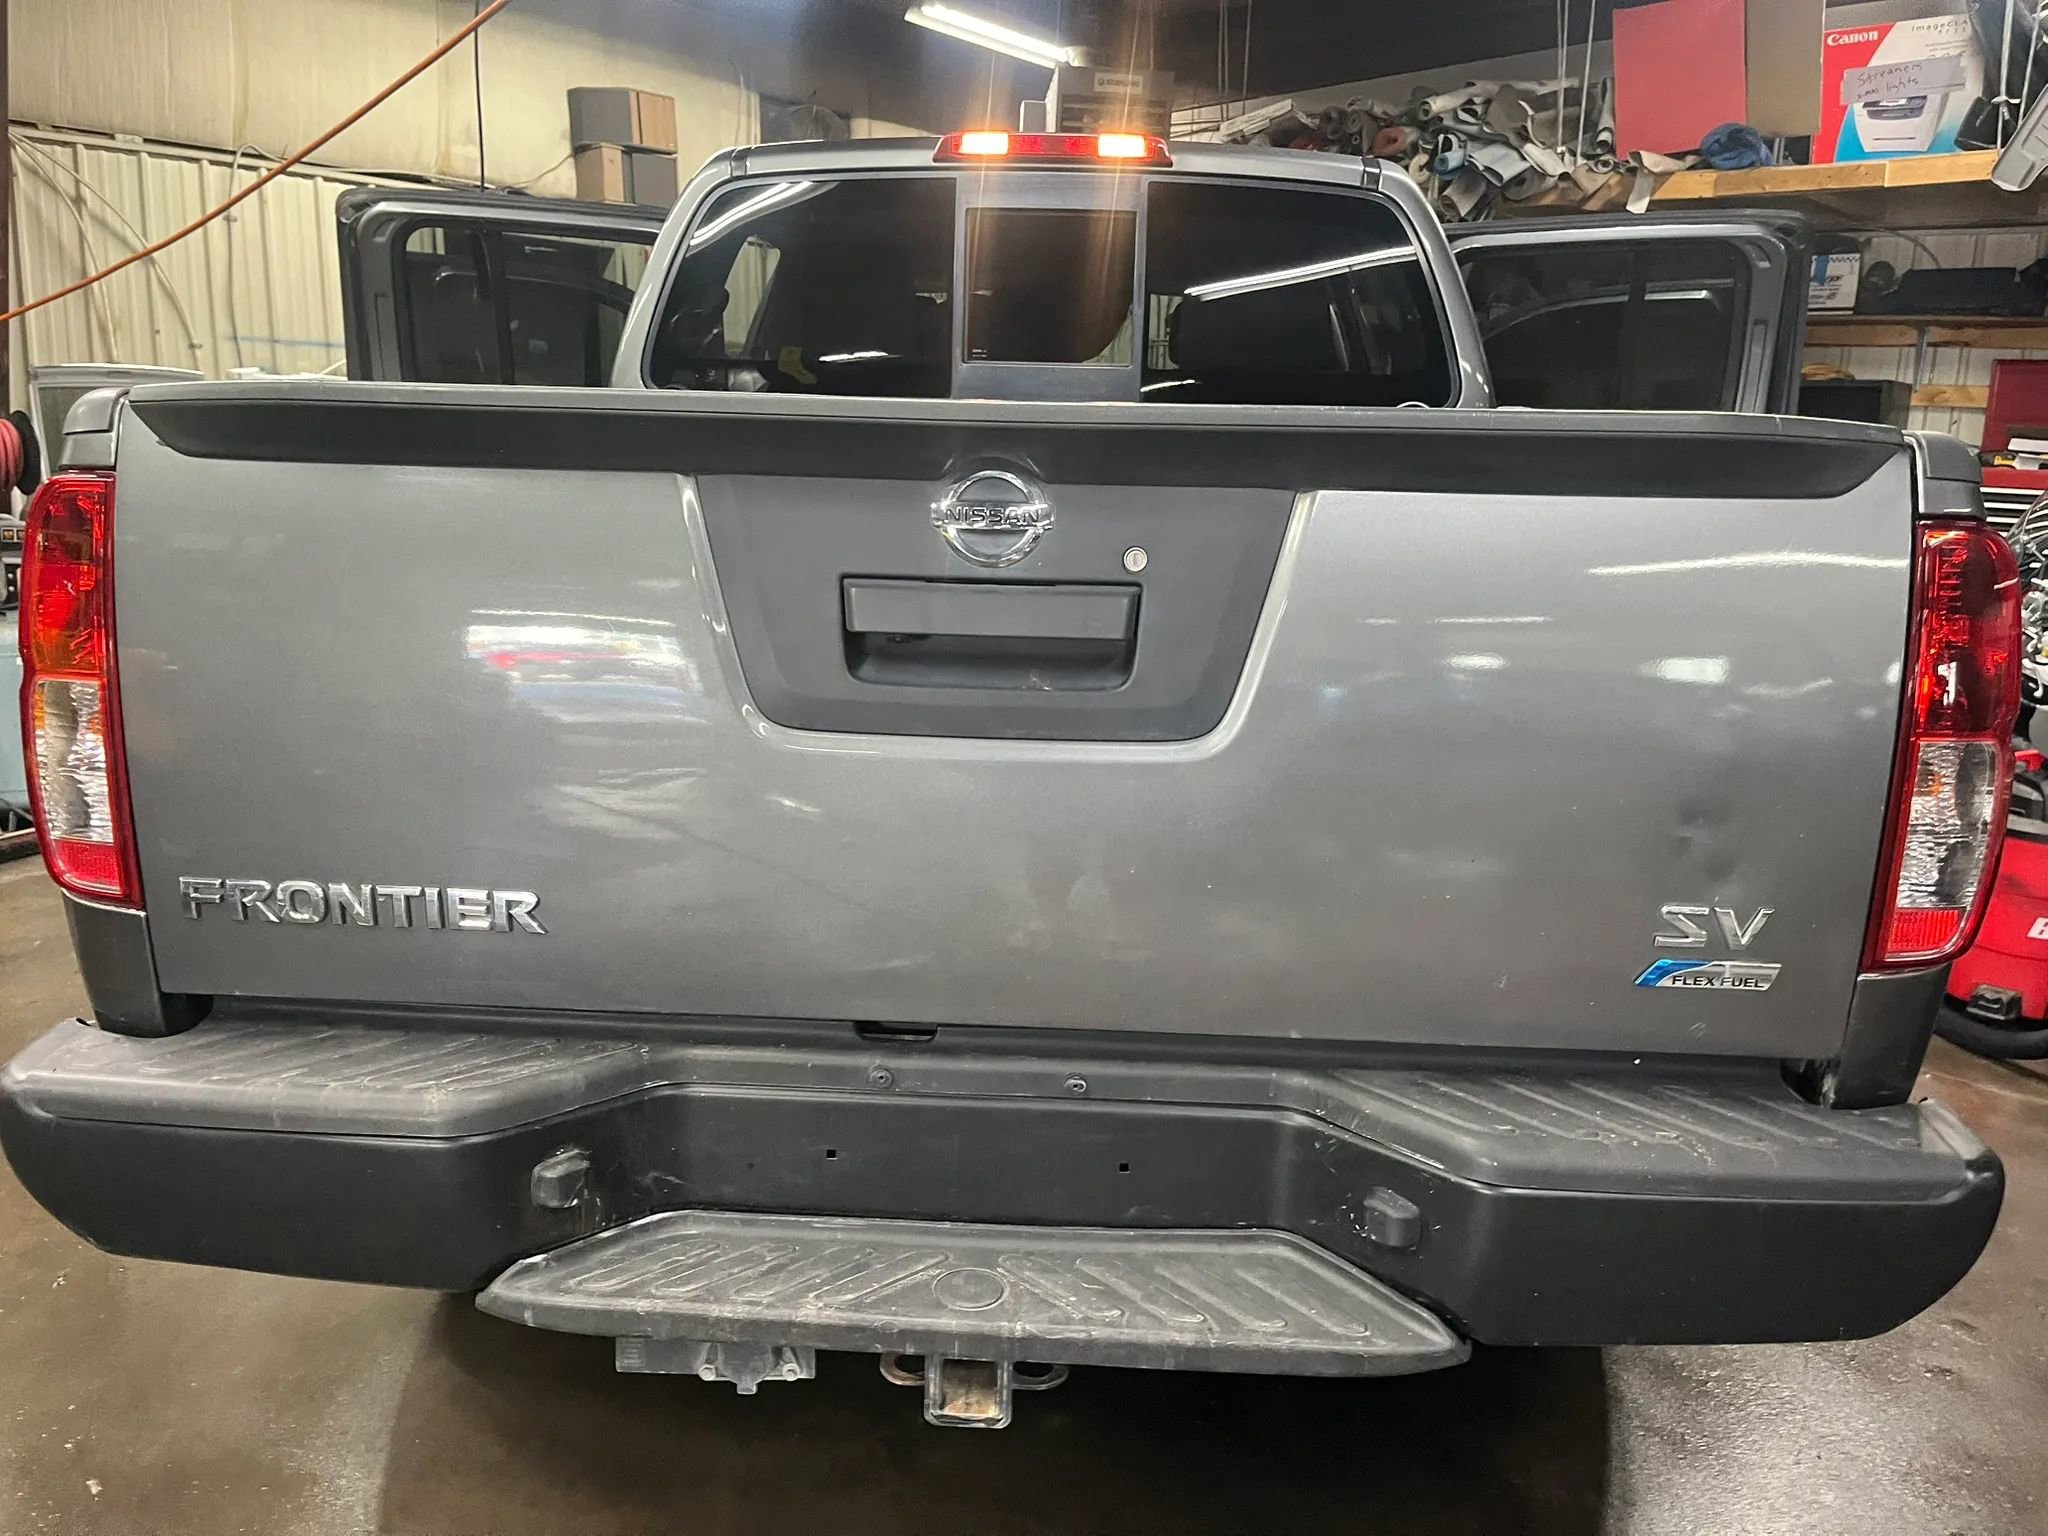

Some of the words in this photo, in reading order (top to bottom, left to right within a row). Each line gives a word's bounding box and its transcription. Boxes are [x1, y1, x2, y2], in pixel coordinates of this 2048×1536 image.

[1826, 31, 1879, 46] Canon
[945, 506, 1040, 524] NISSAN
[178, 876, 550, 936] FRONTIER
[1653, 905, 1775, 951] SV
[1671, 975, 1715, 987] FLEX
[1720, 977, 1765, 988] FUEL
